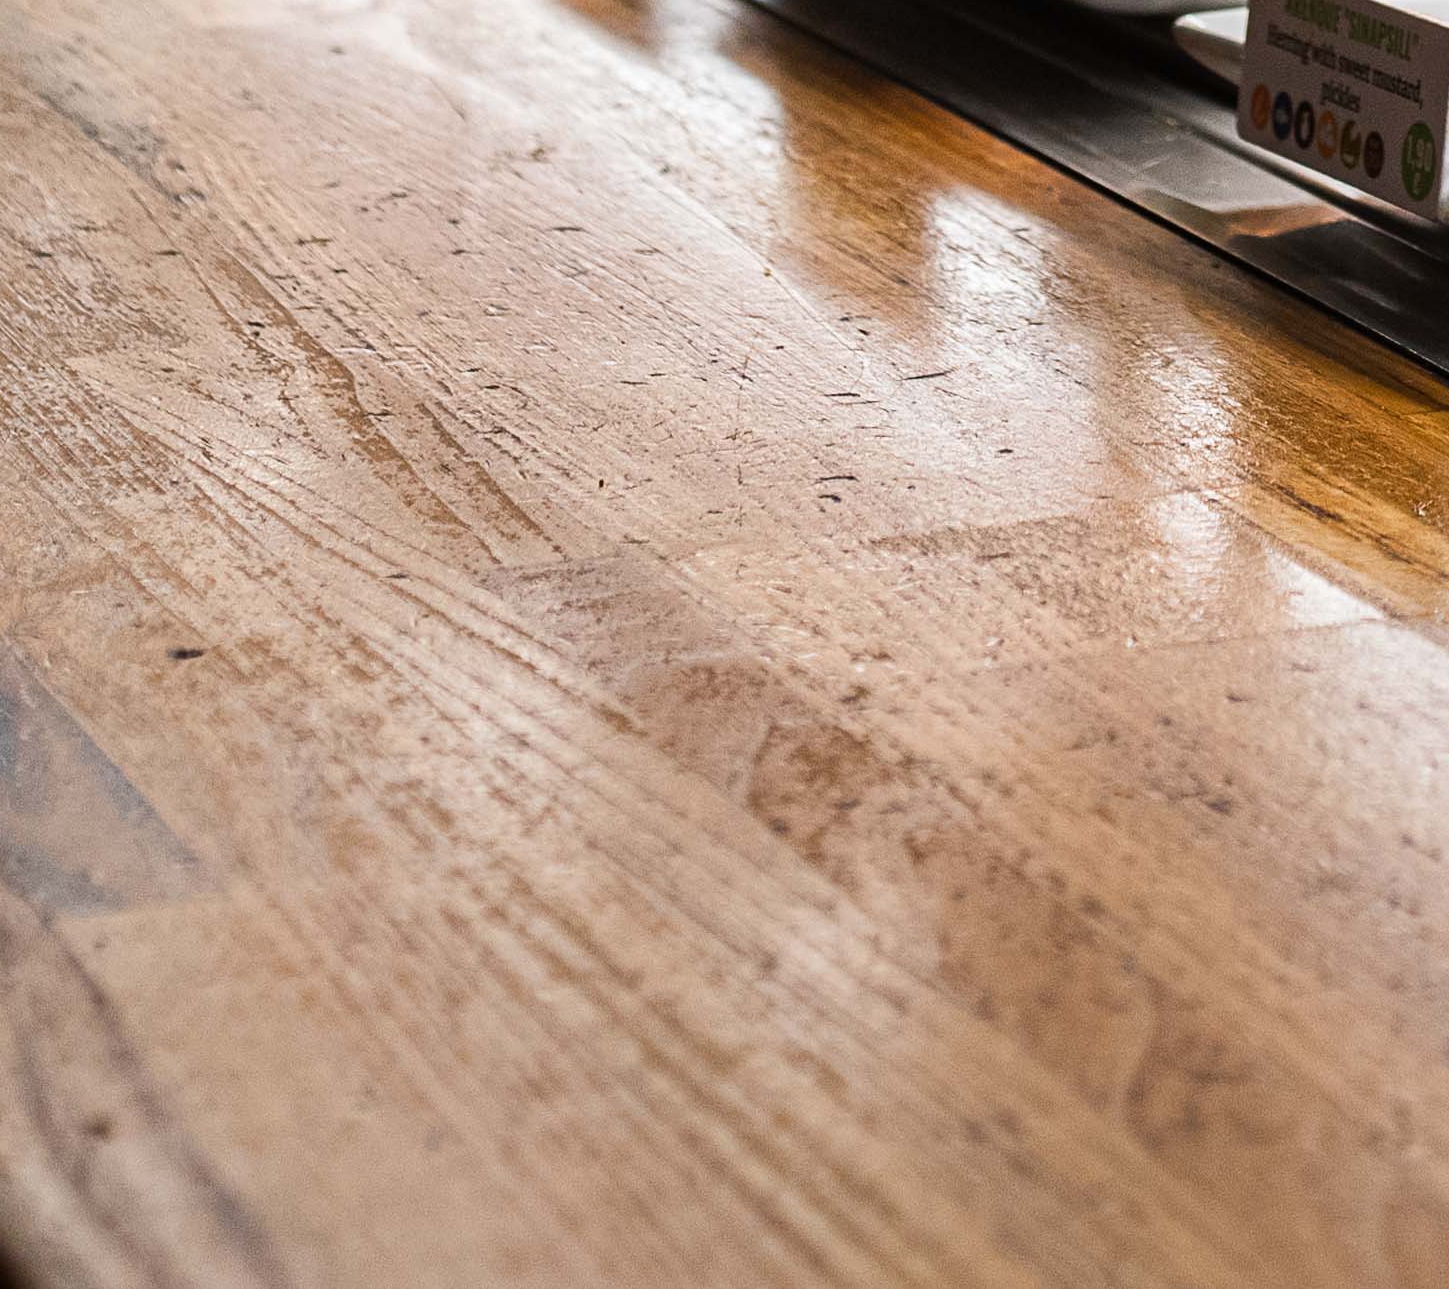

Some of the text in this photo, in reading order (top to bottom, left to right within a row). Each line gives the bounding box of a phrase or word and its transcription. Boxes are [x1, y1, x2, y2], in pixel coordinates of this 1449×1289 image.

[1265, 23, 1311, 66] Herring
[1312, 41, 1337, 70] with
[1338, 54, 1371, 84] sweet
[1320, 80, 1362, 113] pickles
